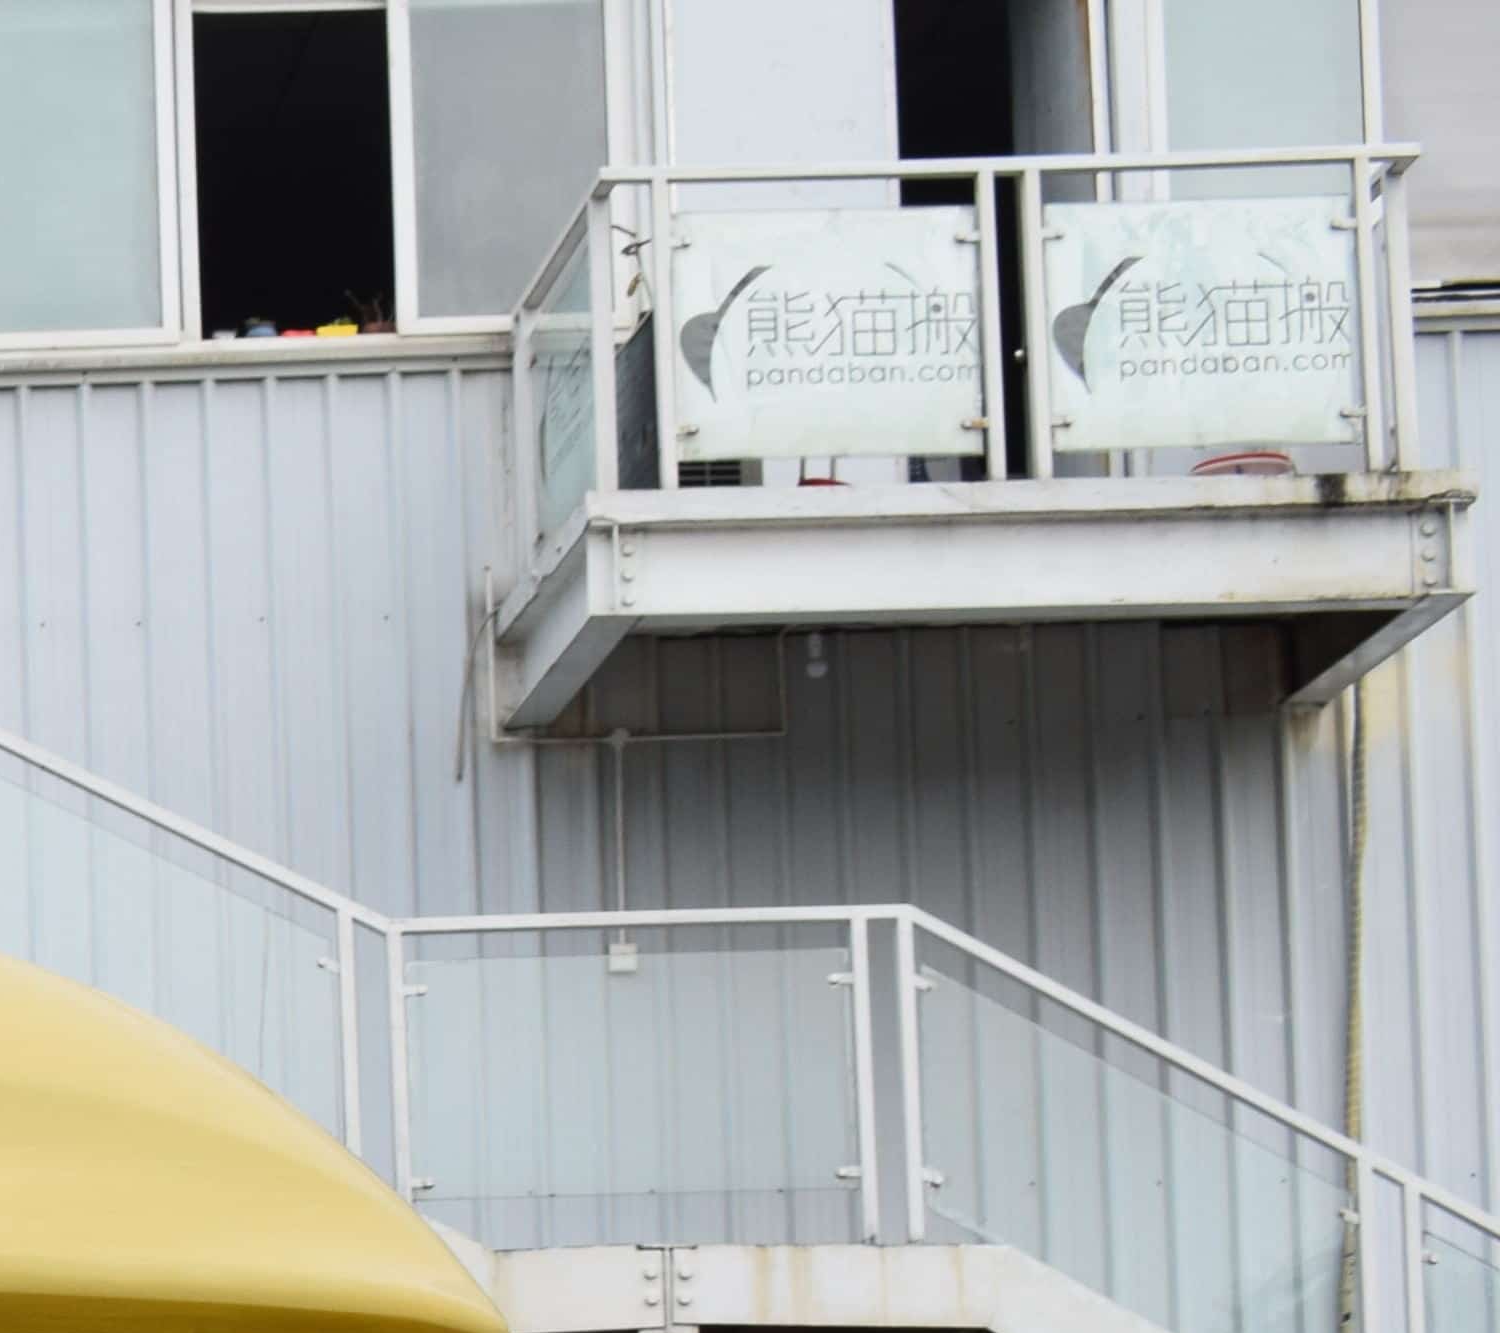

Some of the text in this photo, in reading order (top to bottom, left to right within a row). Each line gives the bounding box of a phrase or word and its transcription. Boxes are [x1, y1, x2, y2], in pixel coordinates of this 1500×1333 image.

[747, 284, 977, 358] 熊猫搬
[1120, 276, 1350, 349] 熊猫搬
[747, 361, 978, 390] pandaban.com
[1120, 352, 1354, 381] pandaban.com
